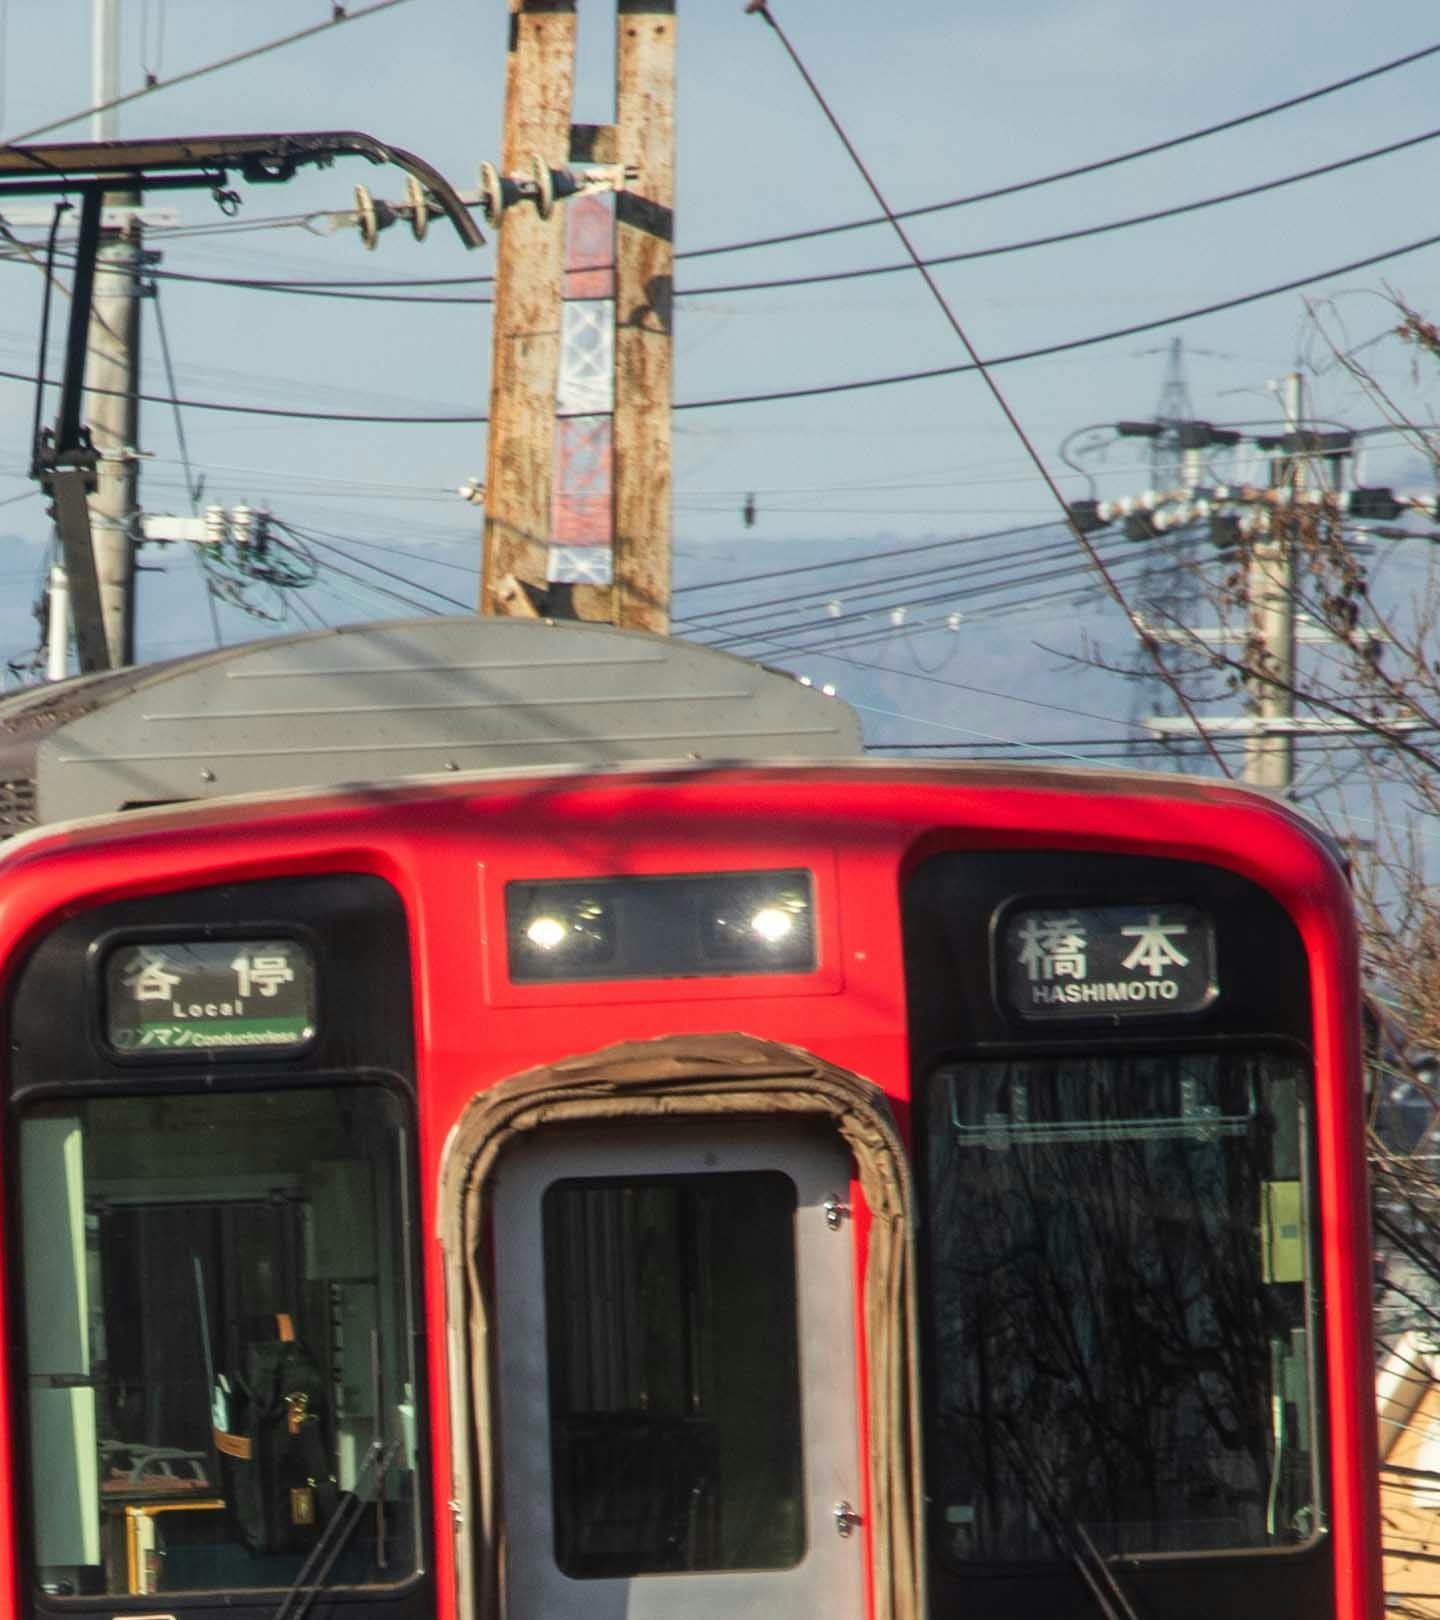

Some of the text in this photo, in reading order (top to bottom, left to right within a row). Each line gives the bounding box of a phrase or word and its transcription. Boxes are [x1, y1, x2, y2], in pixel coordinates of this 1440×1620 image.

[1018, 914, 1190, 980] 橋本
[122, 949, 295, 1001] 各停
[1032, 980, 1178, 1003] HASHIMOTO
[173, 1000, 243, 1018] Local
